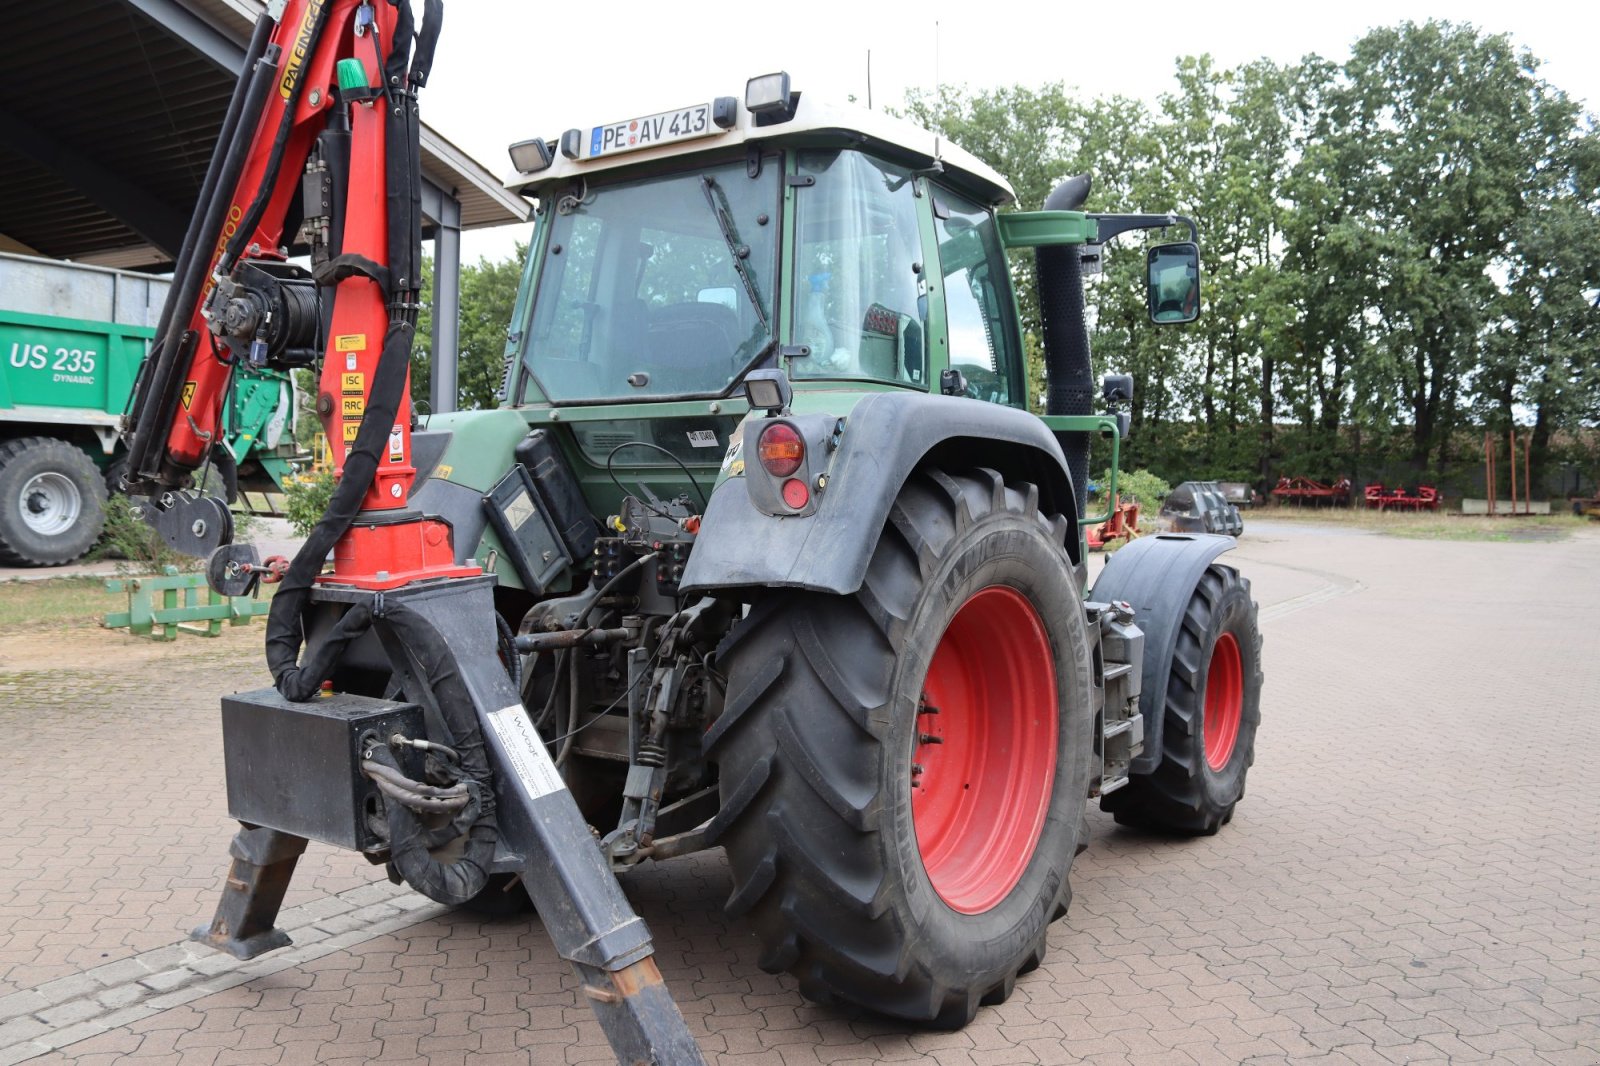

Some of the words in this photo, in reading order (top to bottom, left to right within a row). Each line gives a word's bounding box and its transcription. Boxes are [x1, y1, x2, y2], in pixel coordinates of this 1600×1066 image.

[603, 125, 627, 150] PE
[640, 117, 665, 142] AV
[669, 108, 706, 135] 413
[10, 343, 48, 369] US
[52, 348, 97, 373] 235
[53, 374, 95, 385] DYNAMIC
[345, 376, 360, 385] ISC
[344, 400, 362, 410] RRC
[346, 425, 358, 435] KT
